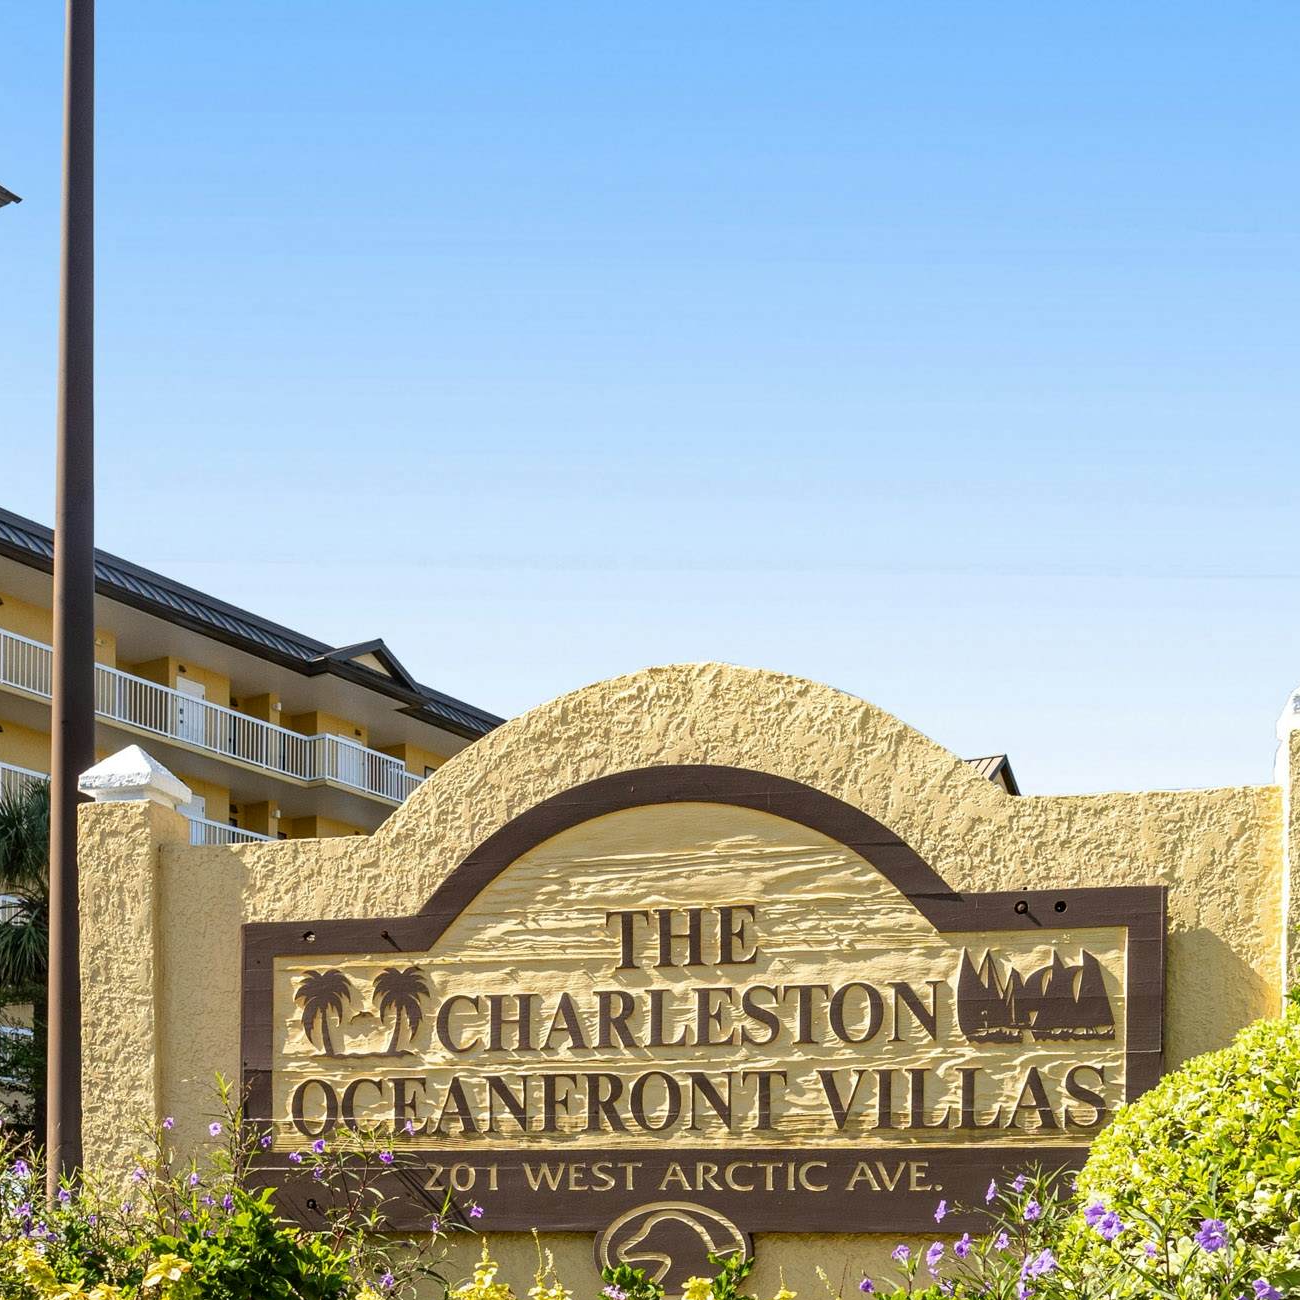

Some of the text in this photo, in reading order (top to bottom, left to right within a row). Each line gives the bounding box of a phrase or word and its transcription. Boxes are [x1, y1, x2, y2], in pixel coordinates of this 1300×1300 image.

[606, 904, 758, 969] THE
[436, 980, 939, 1053] CHARLESTON
[291, 1065, 1107, 1136] OCEANFRONT VILLAS
[424, 1160, 943, 1192] 201 WEST ARCTIC AVE.
